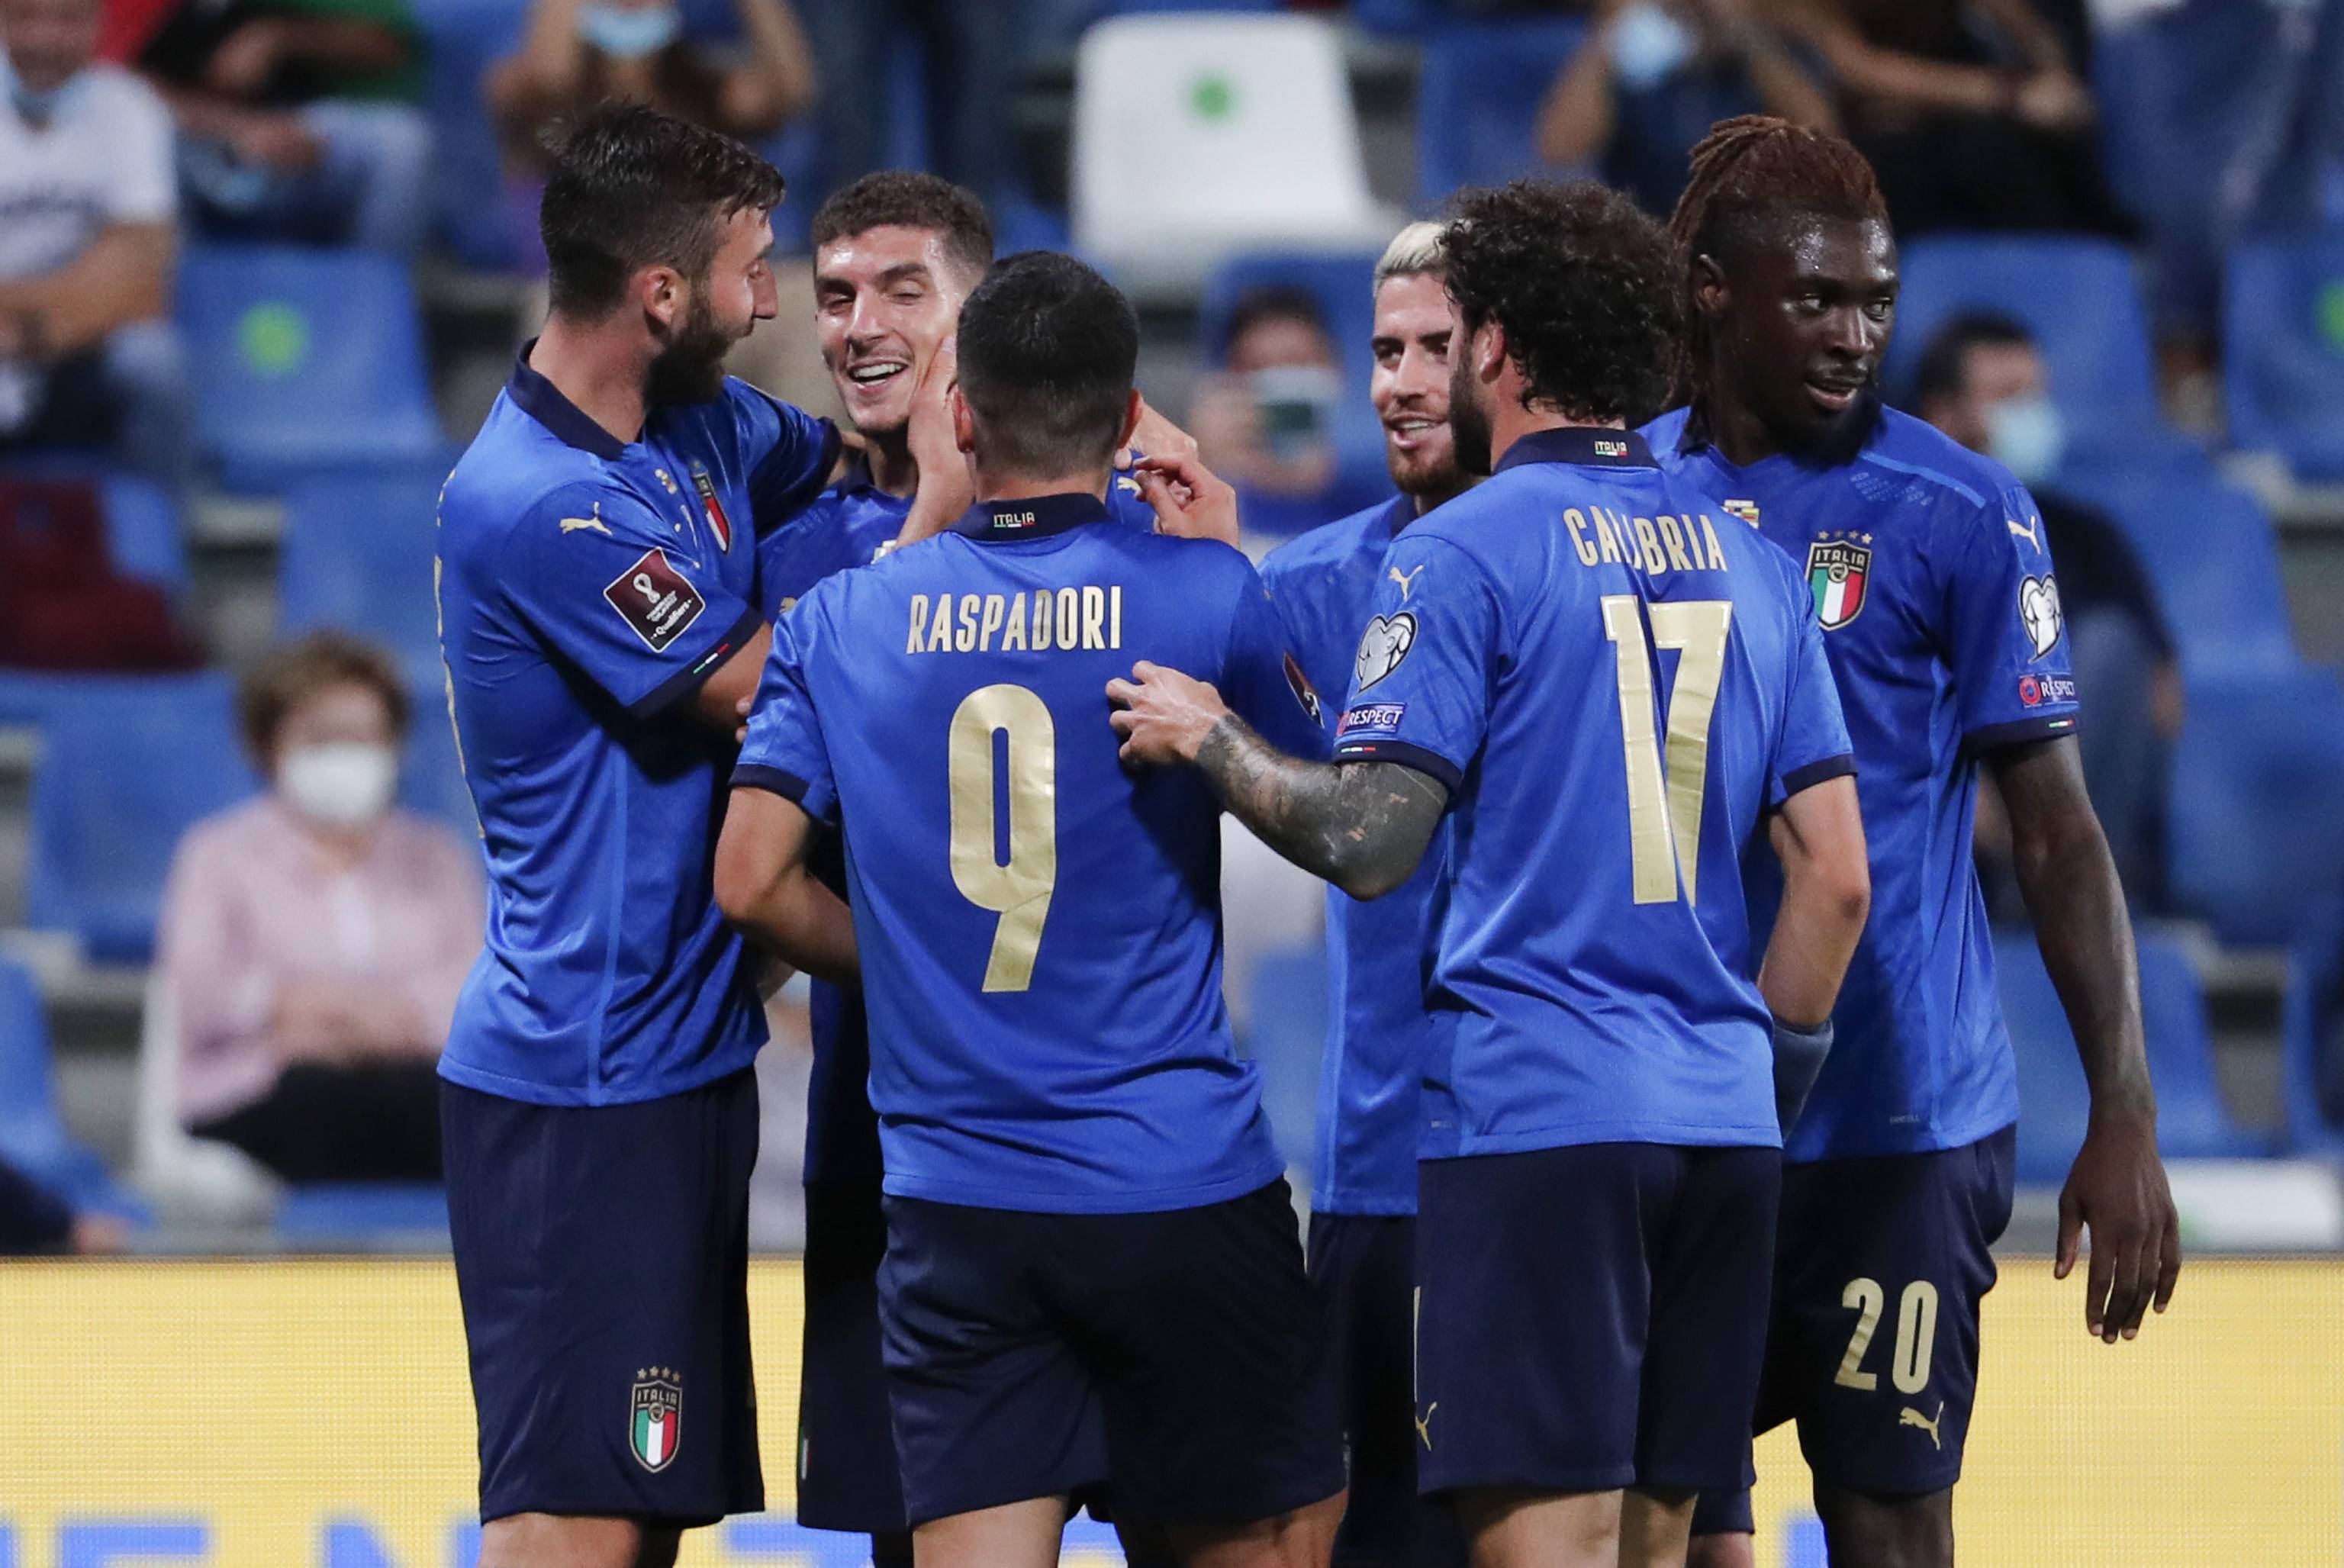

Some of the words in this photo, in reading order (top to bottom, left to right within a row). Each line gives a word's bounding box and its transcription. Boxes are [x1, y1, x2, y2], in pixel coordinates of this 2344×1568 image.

[1595, 441, 1628, 452] ITALIA
[993, 512, 1035, 525] ITALIA
[1816, 549, 1866, 567] ITALIA
[906, 585, 1122, 654] RASPADORI
[1347, 709, 1404, 726] RESPECT
[1600, 595, 1733, 907] 17
[948, 684, 1056, 993] 9
[1834, 1277, 1938, 1395] 20
[637, 1389, 678, 1405] ITALIA
